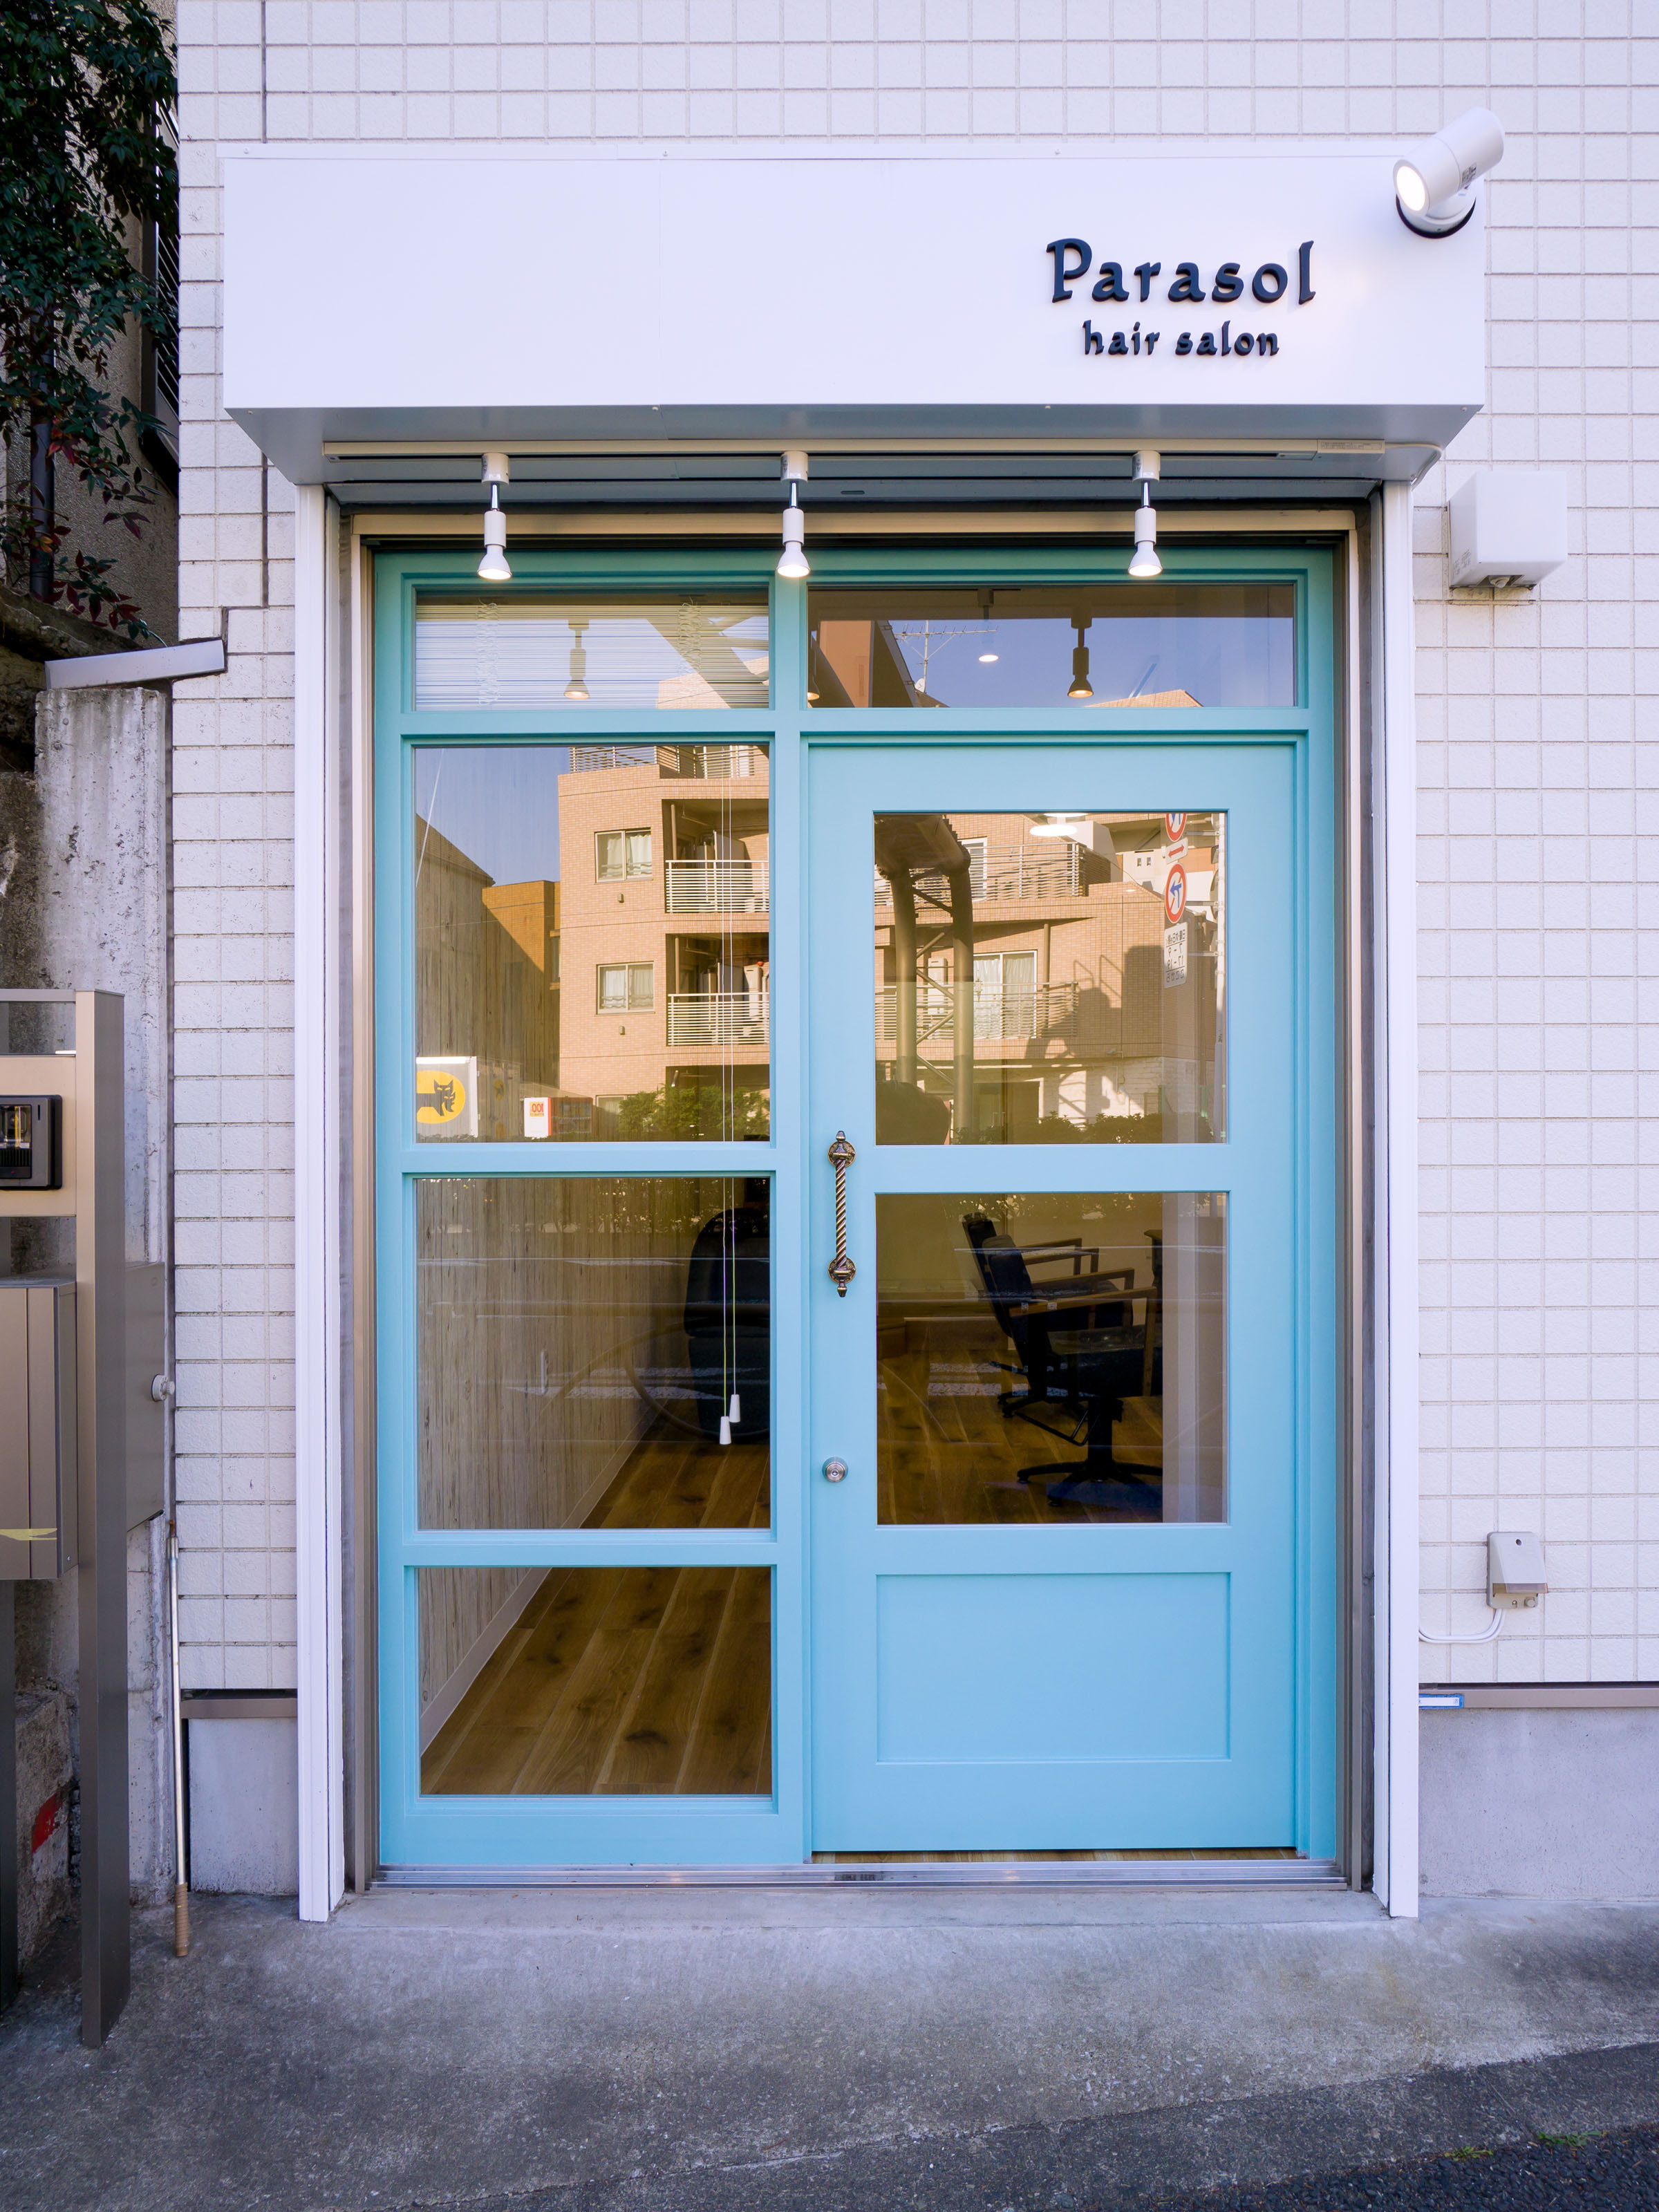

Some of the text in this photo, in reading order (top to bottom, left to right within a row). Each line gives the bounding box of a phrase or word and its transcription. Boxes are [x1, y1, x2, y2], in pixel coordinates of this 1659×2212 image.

[1046, 238, 1316, 305] Parasol
[1082, 319, 1280, 356] hair salon
